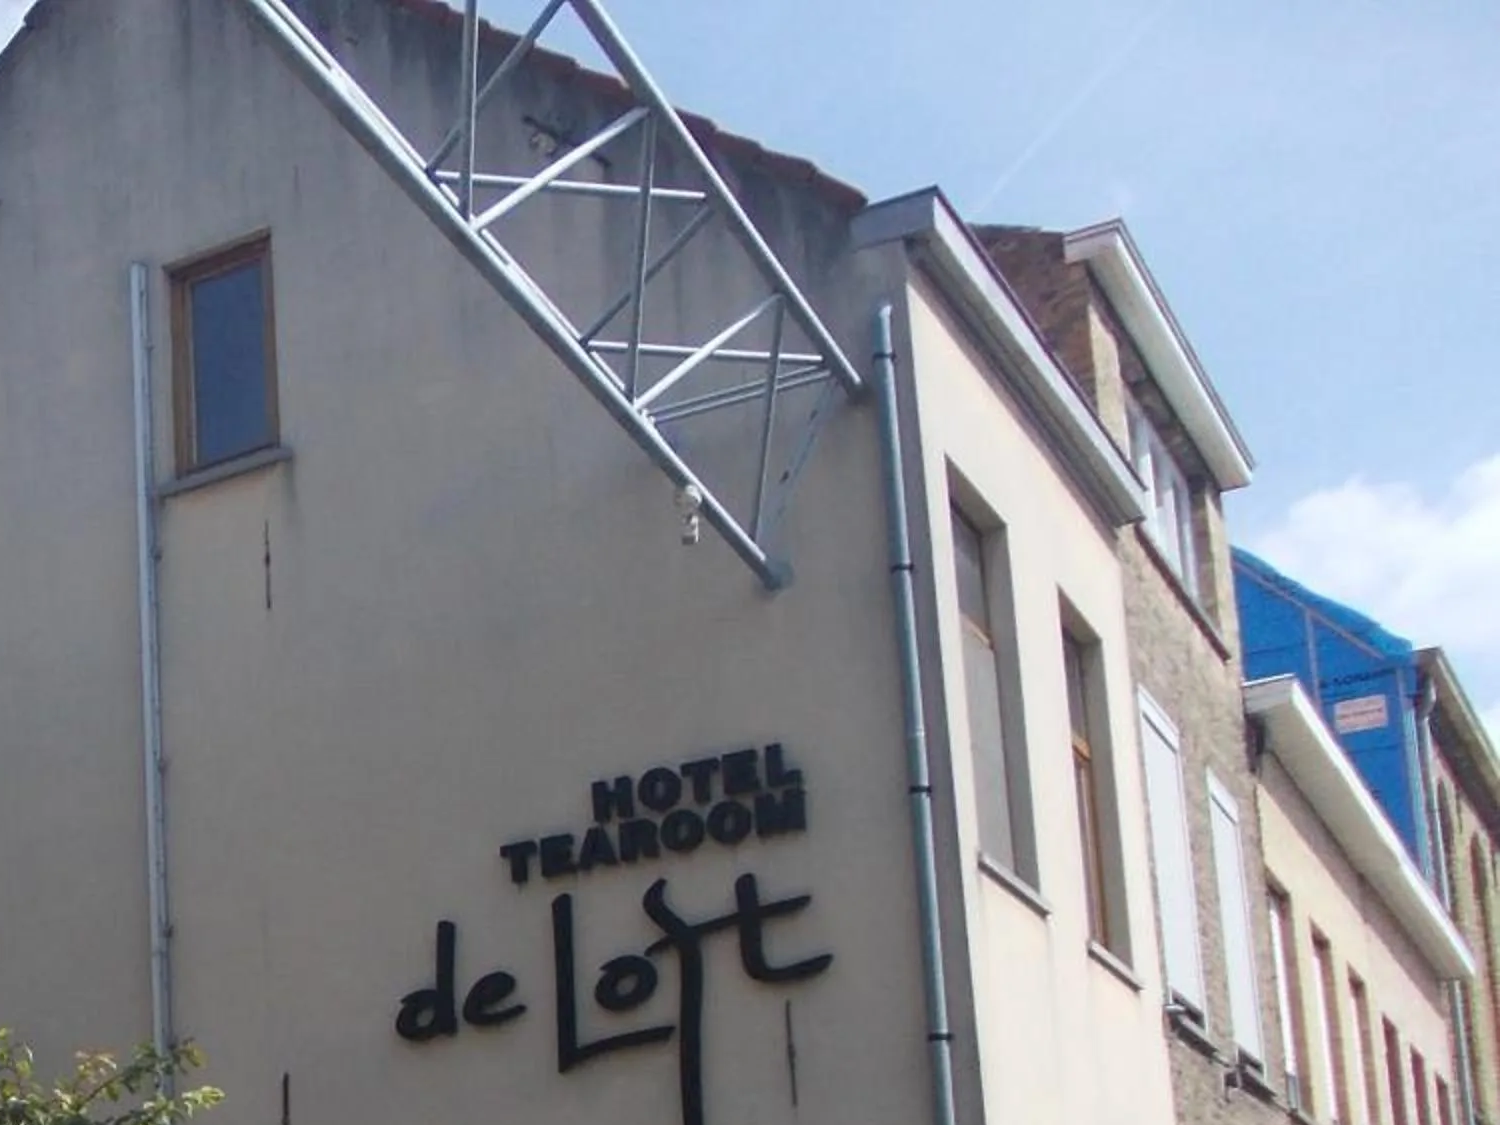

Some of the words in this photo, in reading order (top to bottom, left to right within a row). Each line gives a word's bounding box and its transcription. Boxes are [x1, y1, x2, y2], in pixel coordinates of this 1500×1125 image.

[591, 743, 804, 822] HOTEL
[500, 789, 806, 885] TEAROOM
[396, 920, 527, 1042] de
